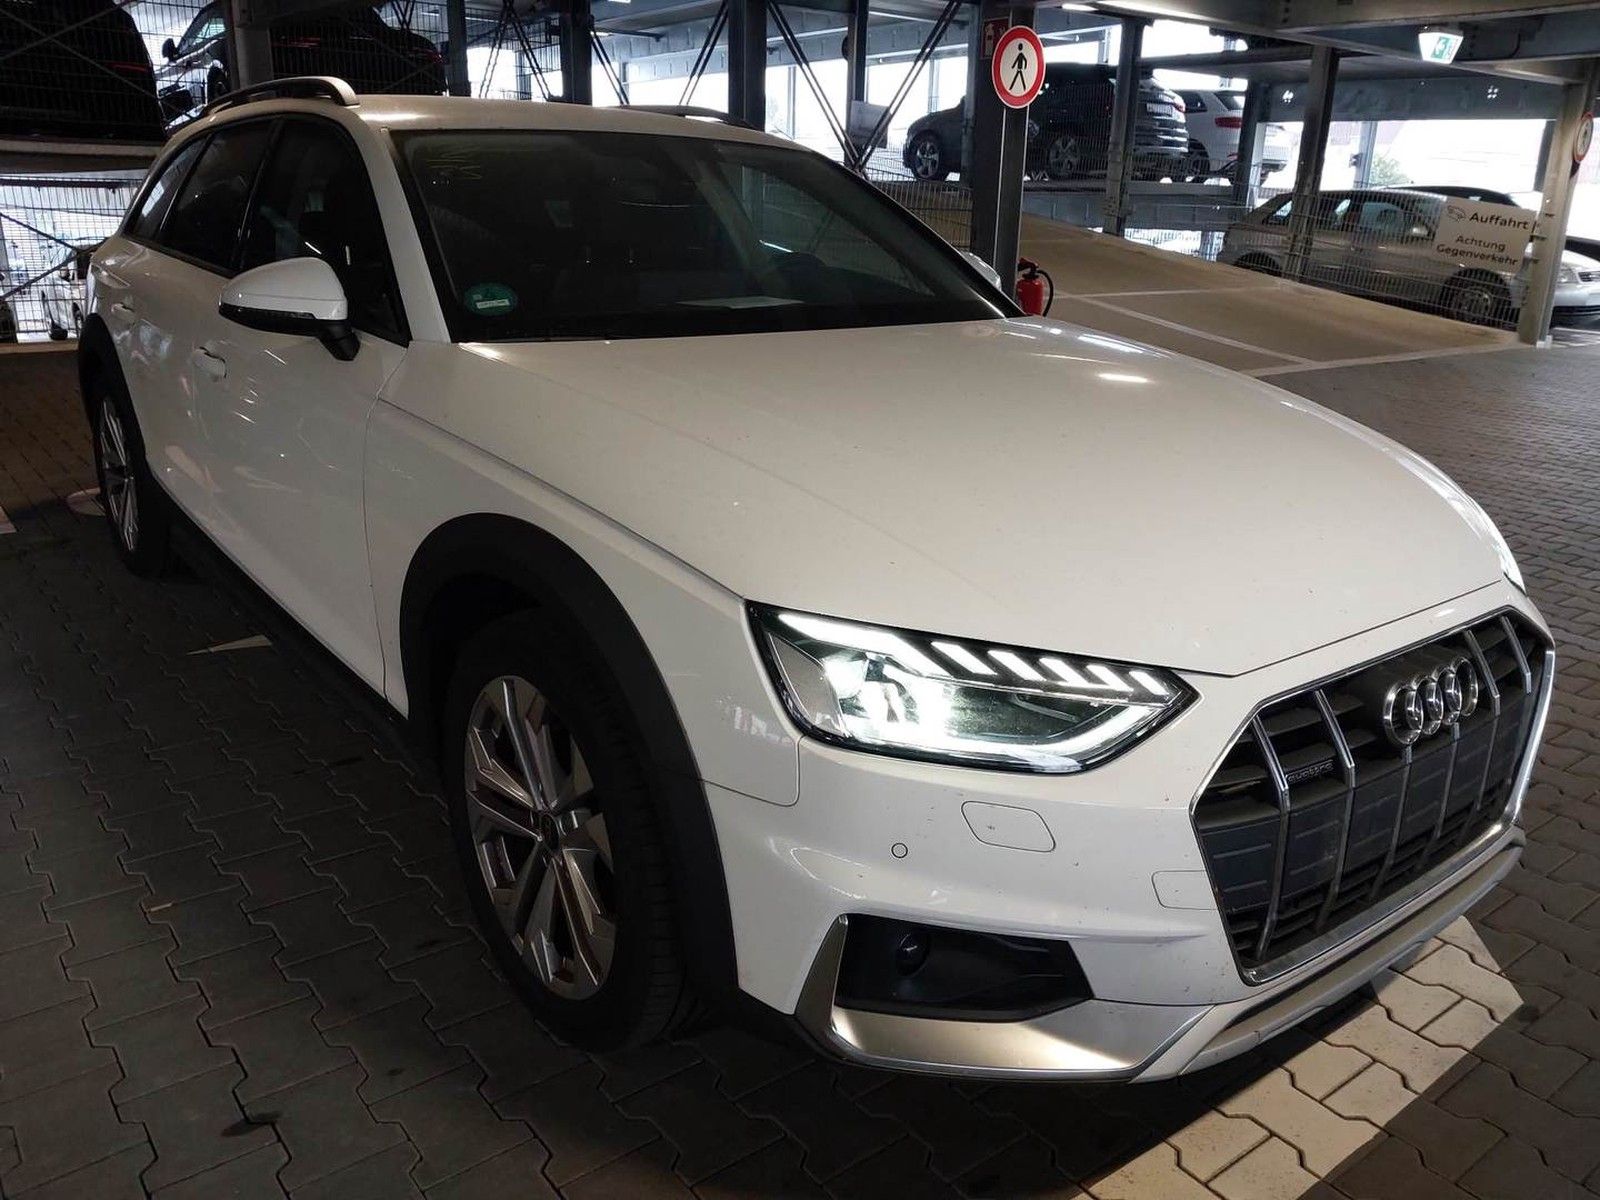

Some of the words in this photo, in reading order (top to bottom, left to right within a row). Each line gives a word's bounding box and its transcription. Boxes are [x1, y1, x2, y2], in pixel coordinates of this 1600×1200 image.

[1469, 212, 1530, 230] Auffahrt
[1455, 235, 1507, 252] Achtung
[1436, 244, 1519, 266] Gegenverkehr
